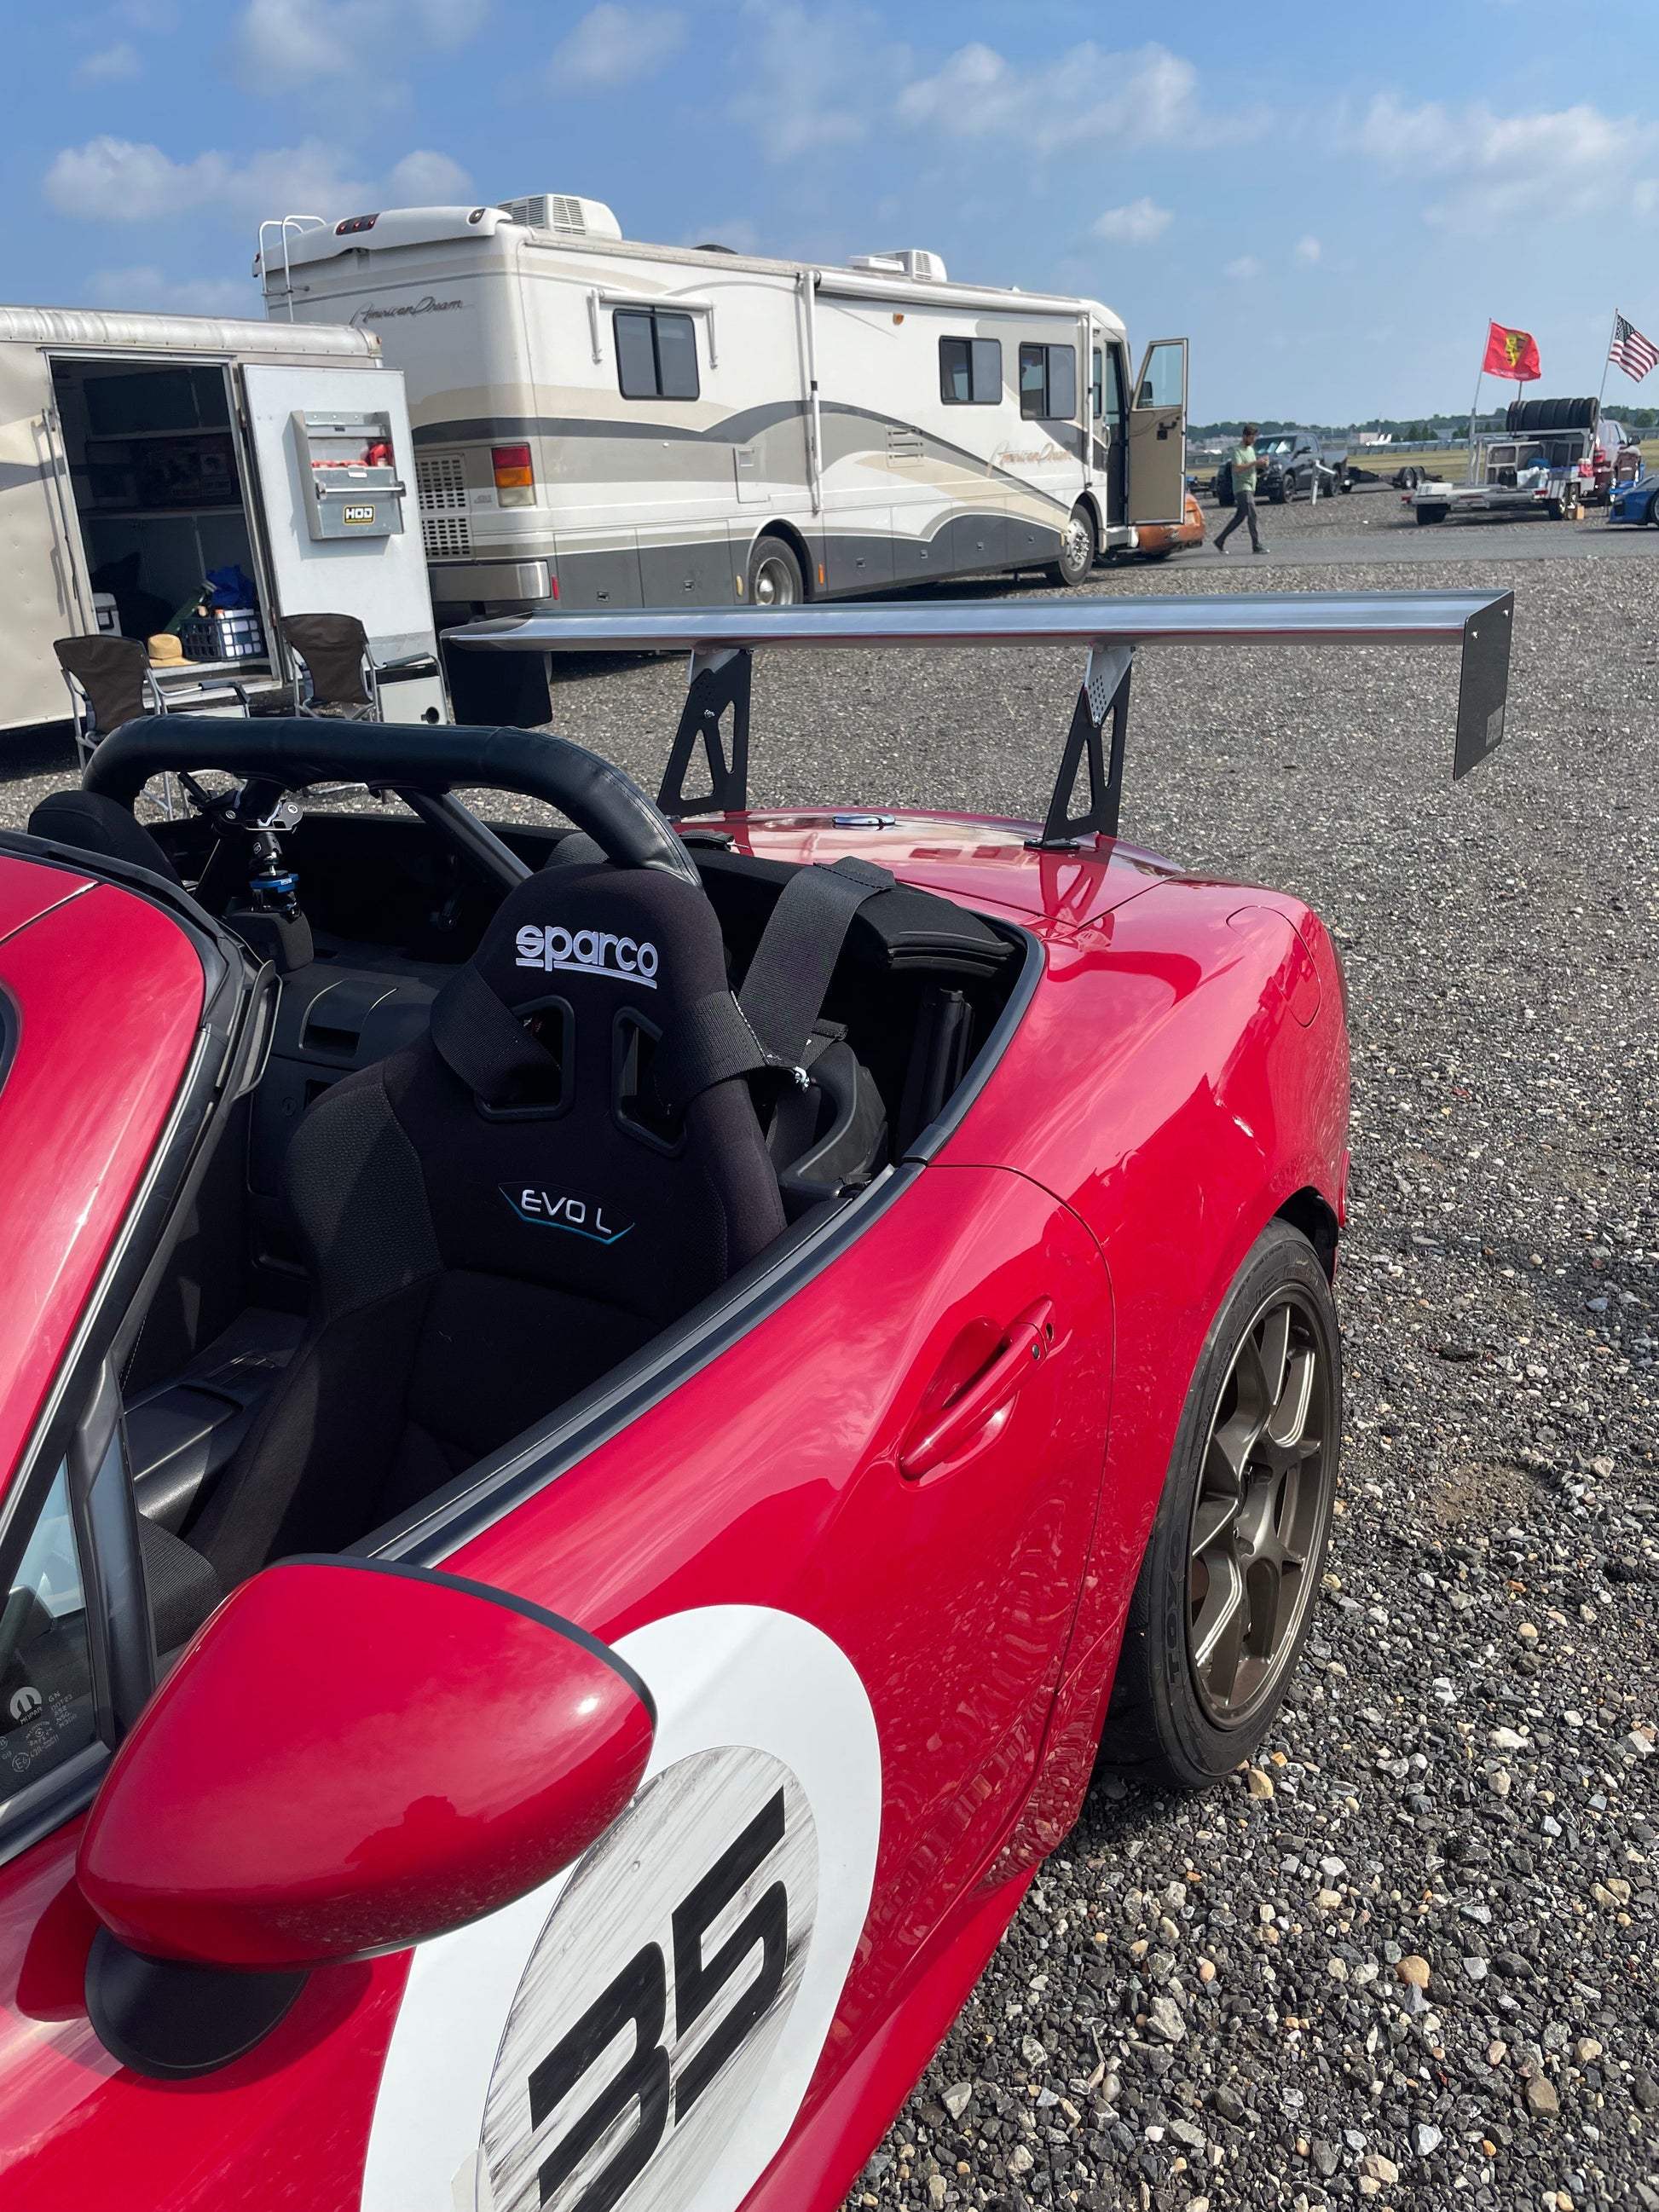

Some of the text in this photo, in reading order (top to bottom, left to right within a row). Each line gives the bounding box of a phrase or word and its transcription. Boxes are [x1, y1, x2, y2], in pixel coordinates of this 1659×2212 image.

[515, 925, 659, 979] sparco
[521, 1189, 612, 1234] EVO L
[1165, 1530, 1180, 1684] TOYO
[20, 1706, 43, 1724] MOPAR
[528, 1784, 789, 2212] 35
